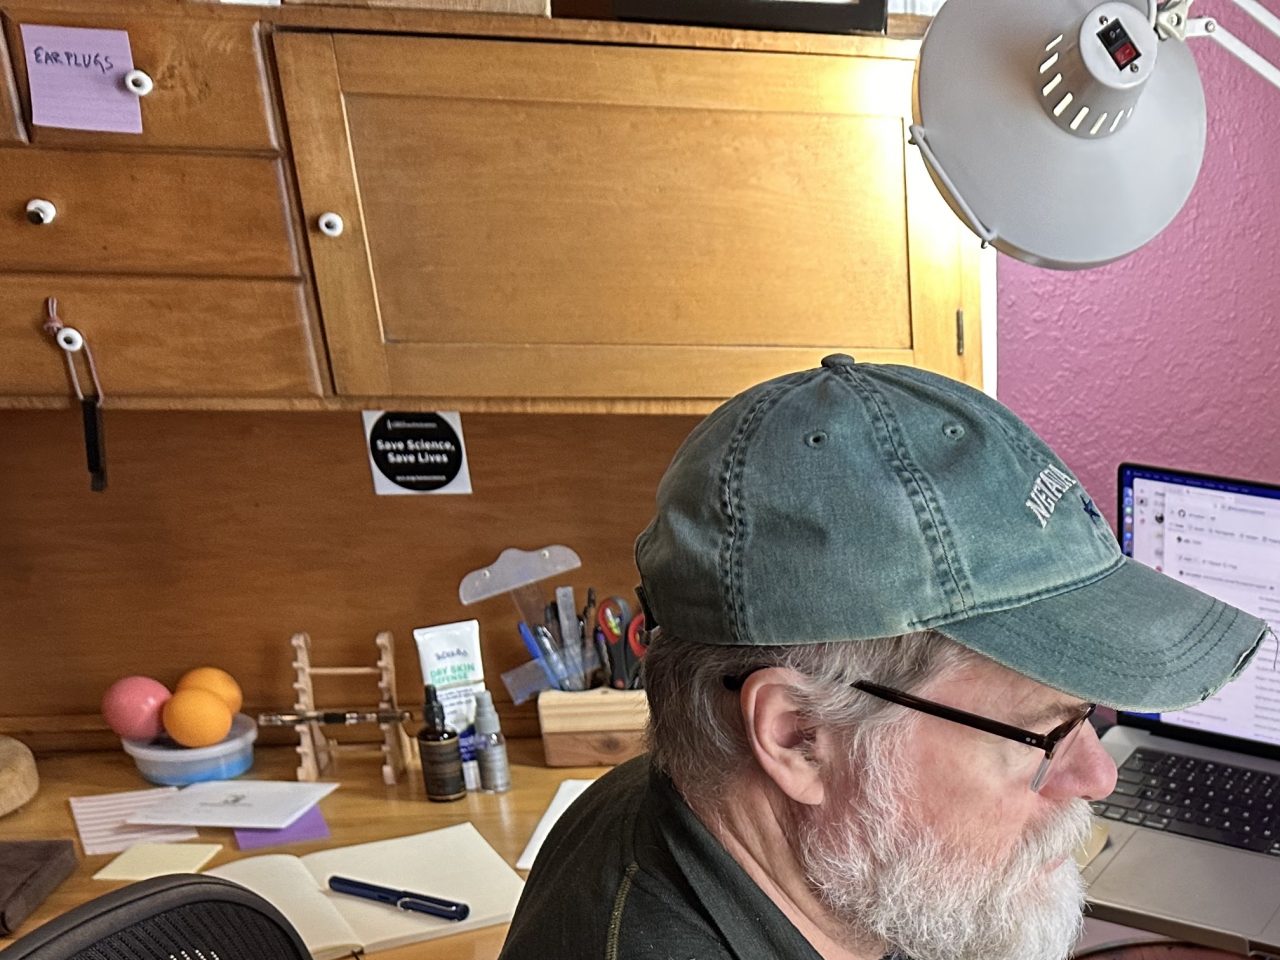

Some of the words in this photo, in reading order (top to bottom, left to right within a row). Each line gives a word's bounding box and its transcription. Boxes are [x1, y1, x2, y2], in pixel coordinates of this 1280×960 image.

[33, 46, 114, 73] EARPLUGS
[376, 439, 405, 451] Save
[387, 451, 416, 464] Save
[417, 451, 449, 464] Lives
